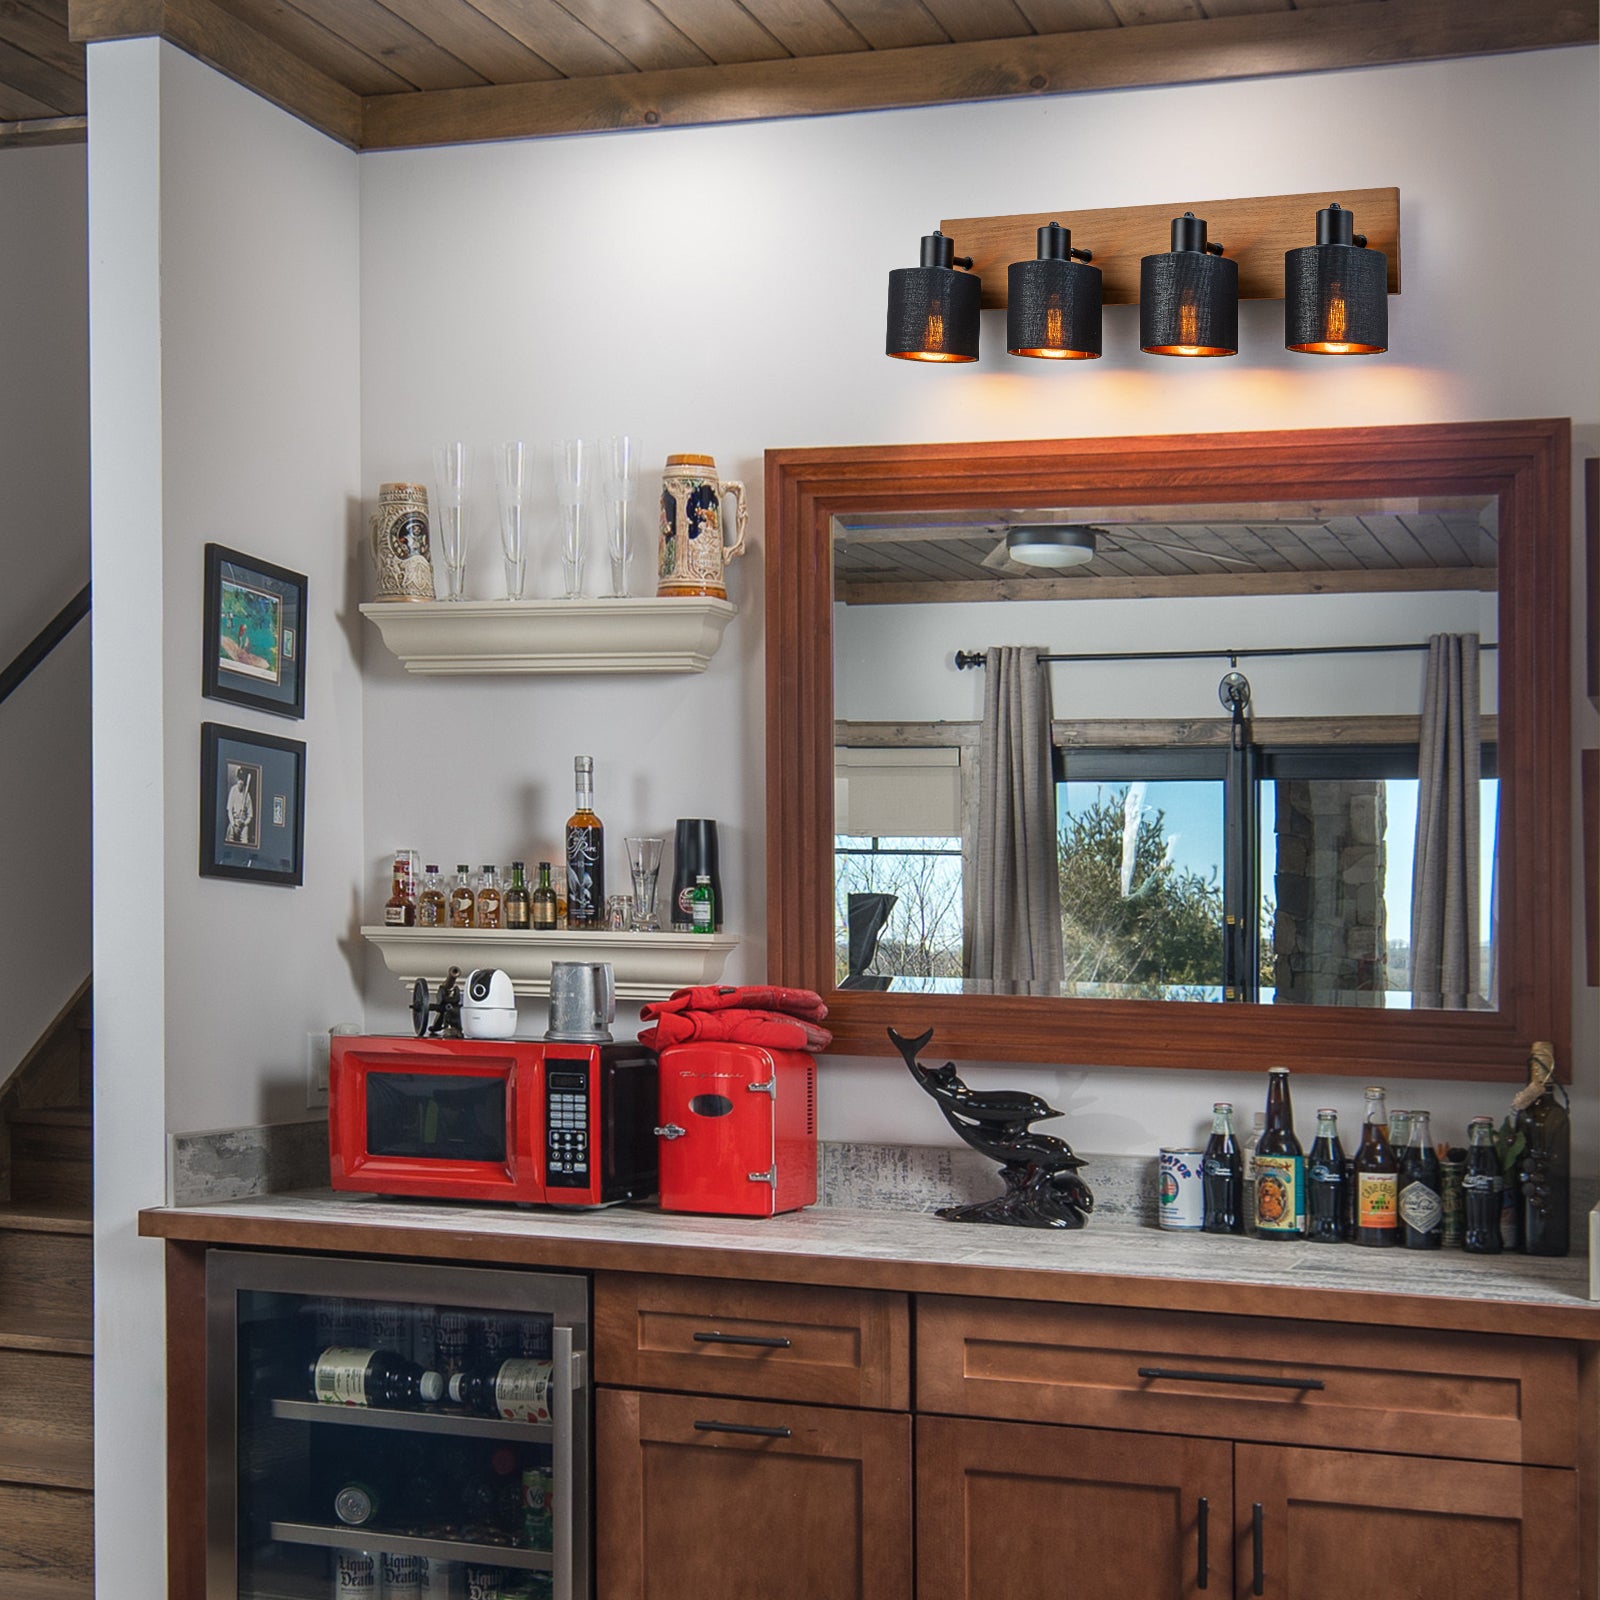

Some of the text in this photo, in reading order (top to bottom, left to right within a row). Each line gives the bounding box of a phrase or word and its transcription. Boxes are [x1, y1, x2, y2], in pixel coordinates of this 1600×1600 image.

[339, 1555, 375, 1574] Liquid
[381, 1552, 418, 1571] Liquid
[341, 1571, 375, 1586] Death
[384, 1568, 418, 1584] Death
